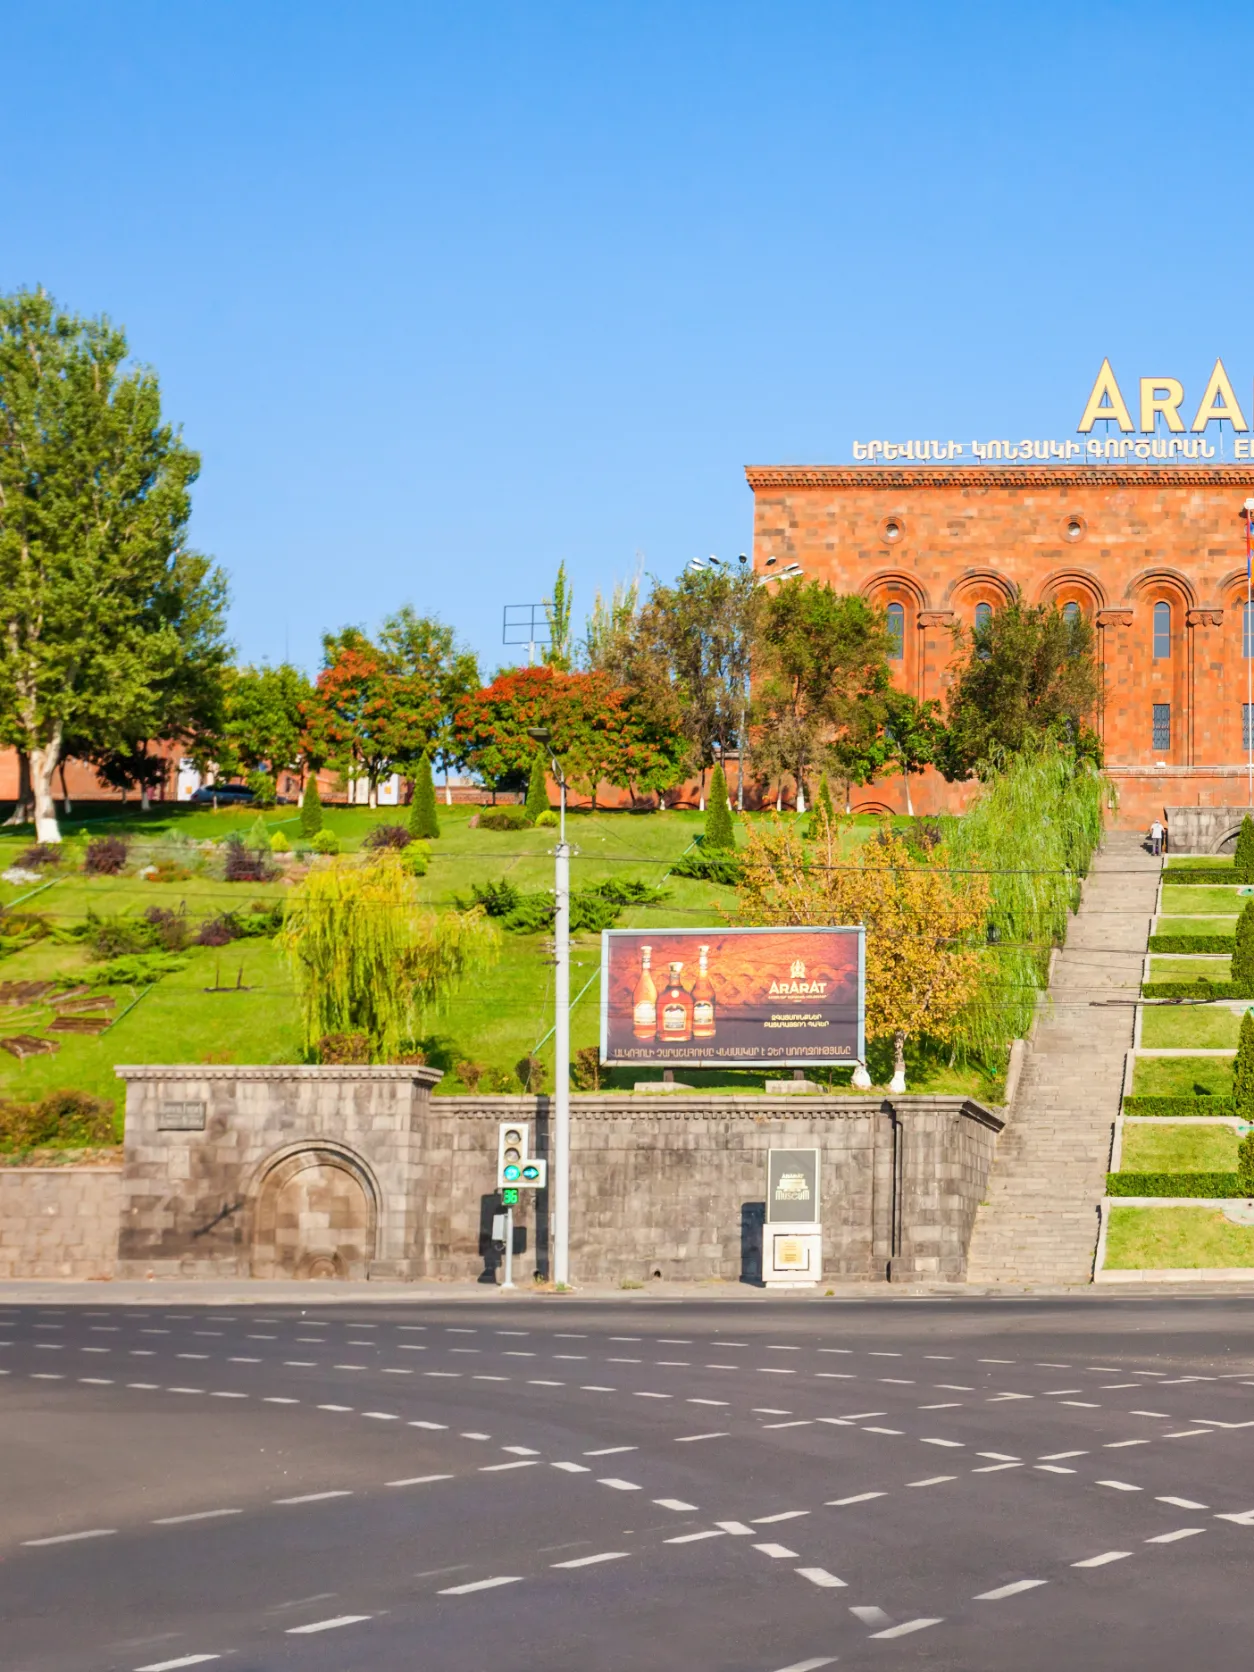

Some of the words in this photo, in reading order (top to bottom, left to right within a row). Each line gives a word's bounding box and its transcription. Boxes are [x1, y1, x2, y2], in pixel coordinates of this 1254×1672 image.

[852, 440, 963, 460] ԵՐԵՎԱՆԻ
[972, 440, 1080, 459] ԿՈՆՅԱԿԻ
[1087, 438, 1215, 459] ԳՈՐԾԱՐԱՆ
[769, 980, 827, 994] ARARAT
[504, 1190, 517, 1204] 36
